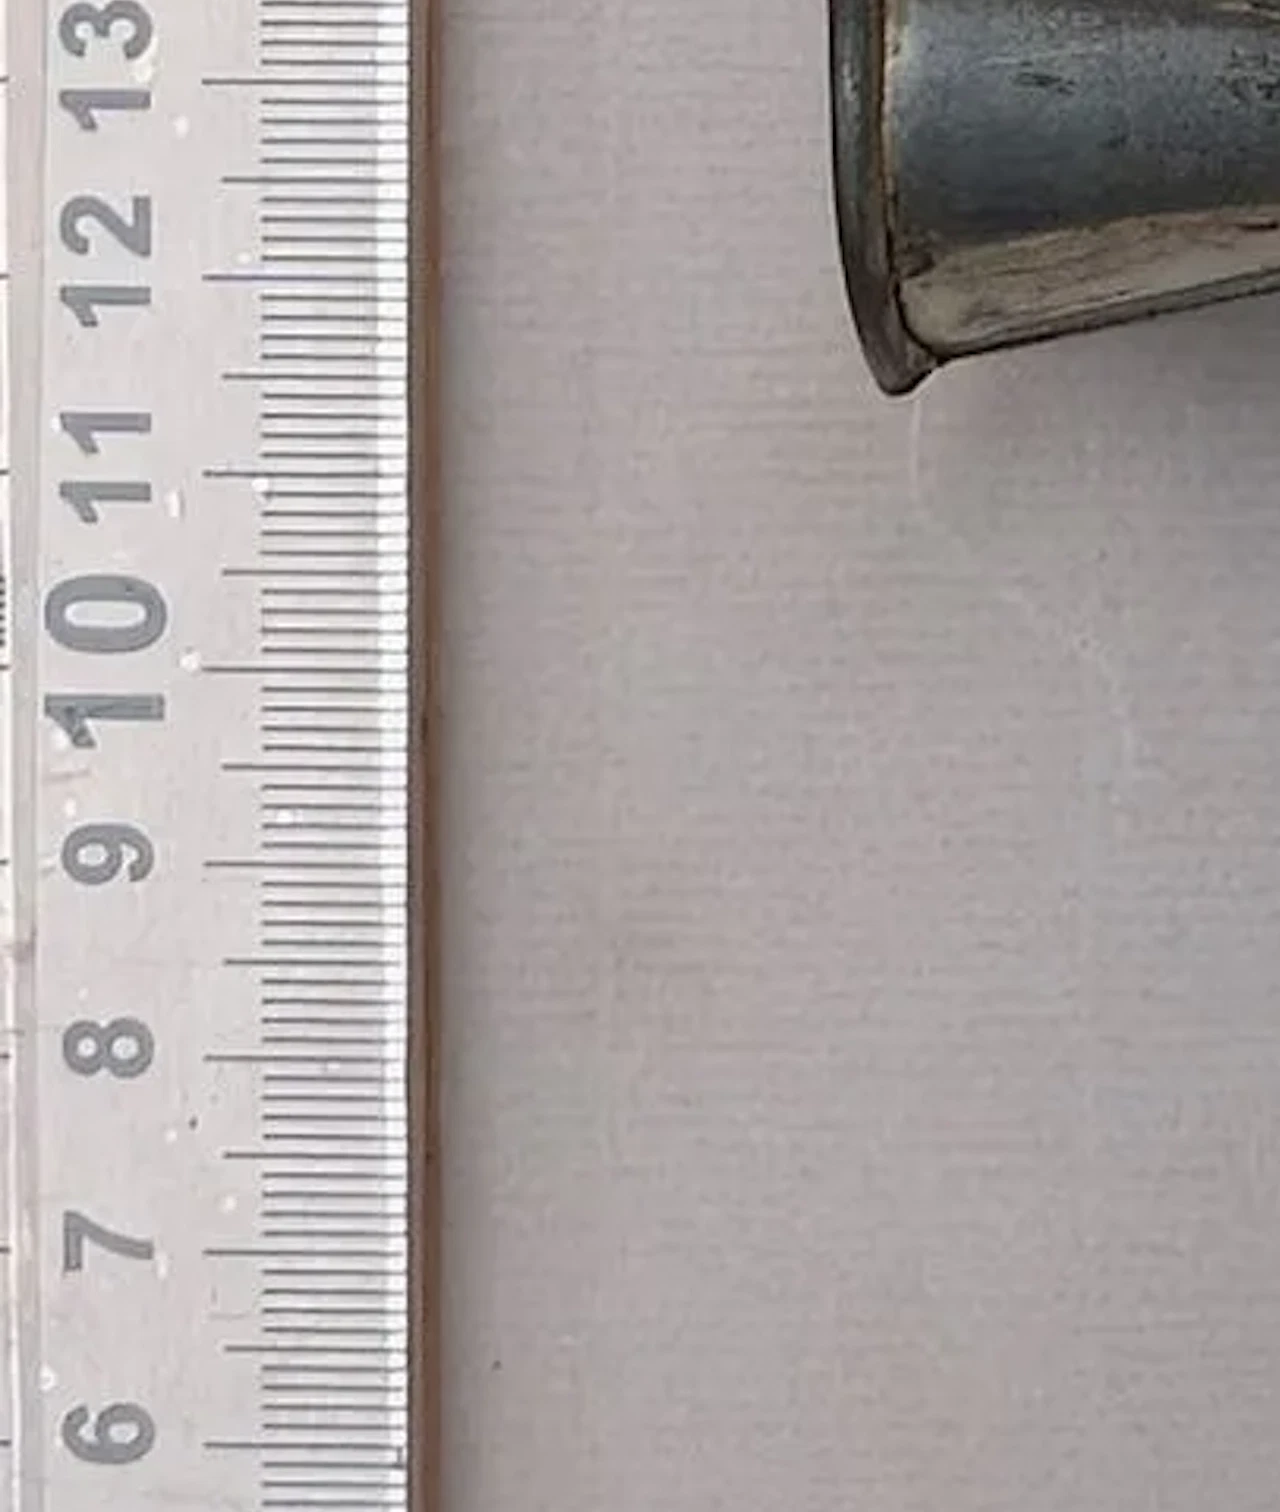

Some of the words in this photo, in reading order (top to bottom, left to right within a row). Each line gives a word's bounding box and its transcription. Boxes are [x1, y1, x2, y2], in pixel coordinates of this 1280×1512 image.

[59, 0, 153, 132] 13
[60, 196, 151, 328] 12
[59, 412, 151, 523] 11
[44, 576, 167, 748] 10
[61, 824, 154, 885] 9
[63, 1018, 154, 1078] 8
[63, 1211, 154, 1274] 7
[62, 1403, 155, 1465] 6
